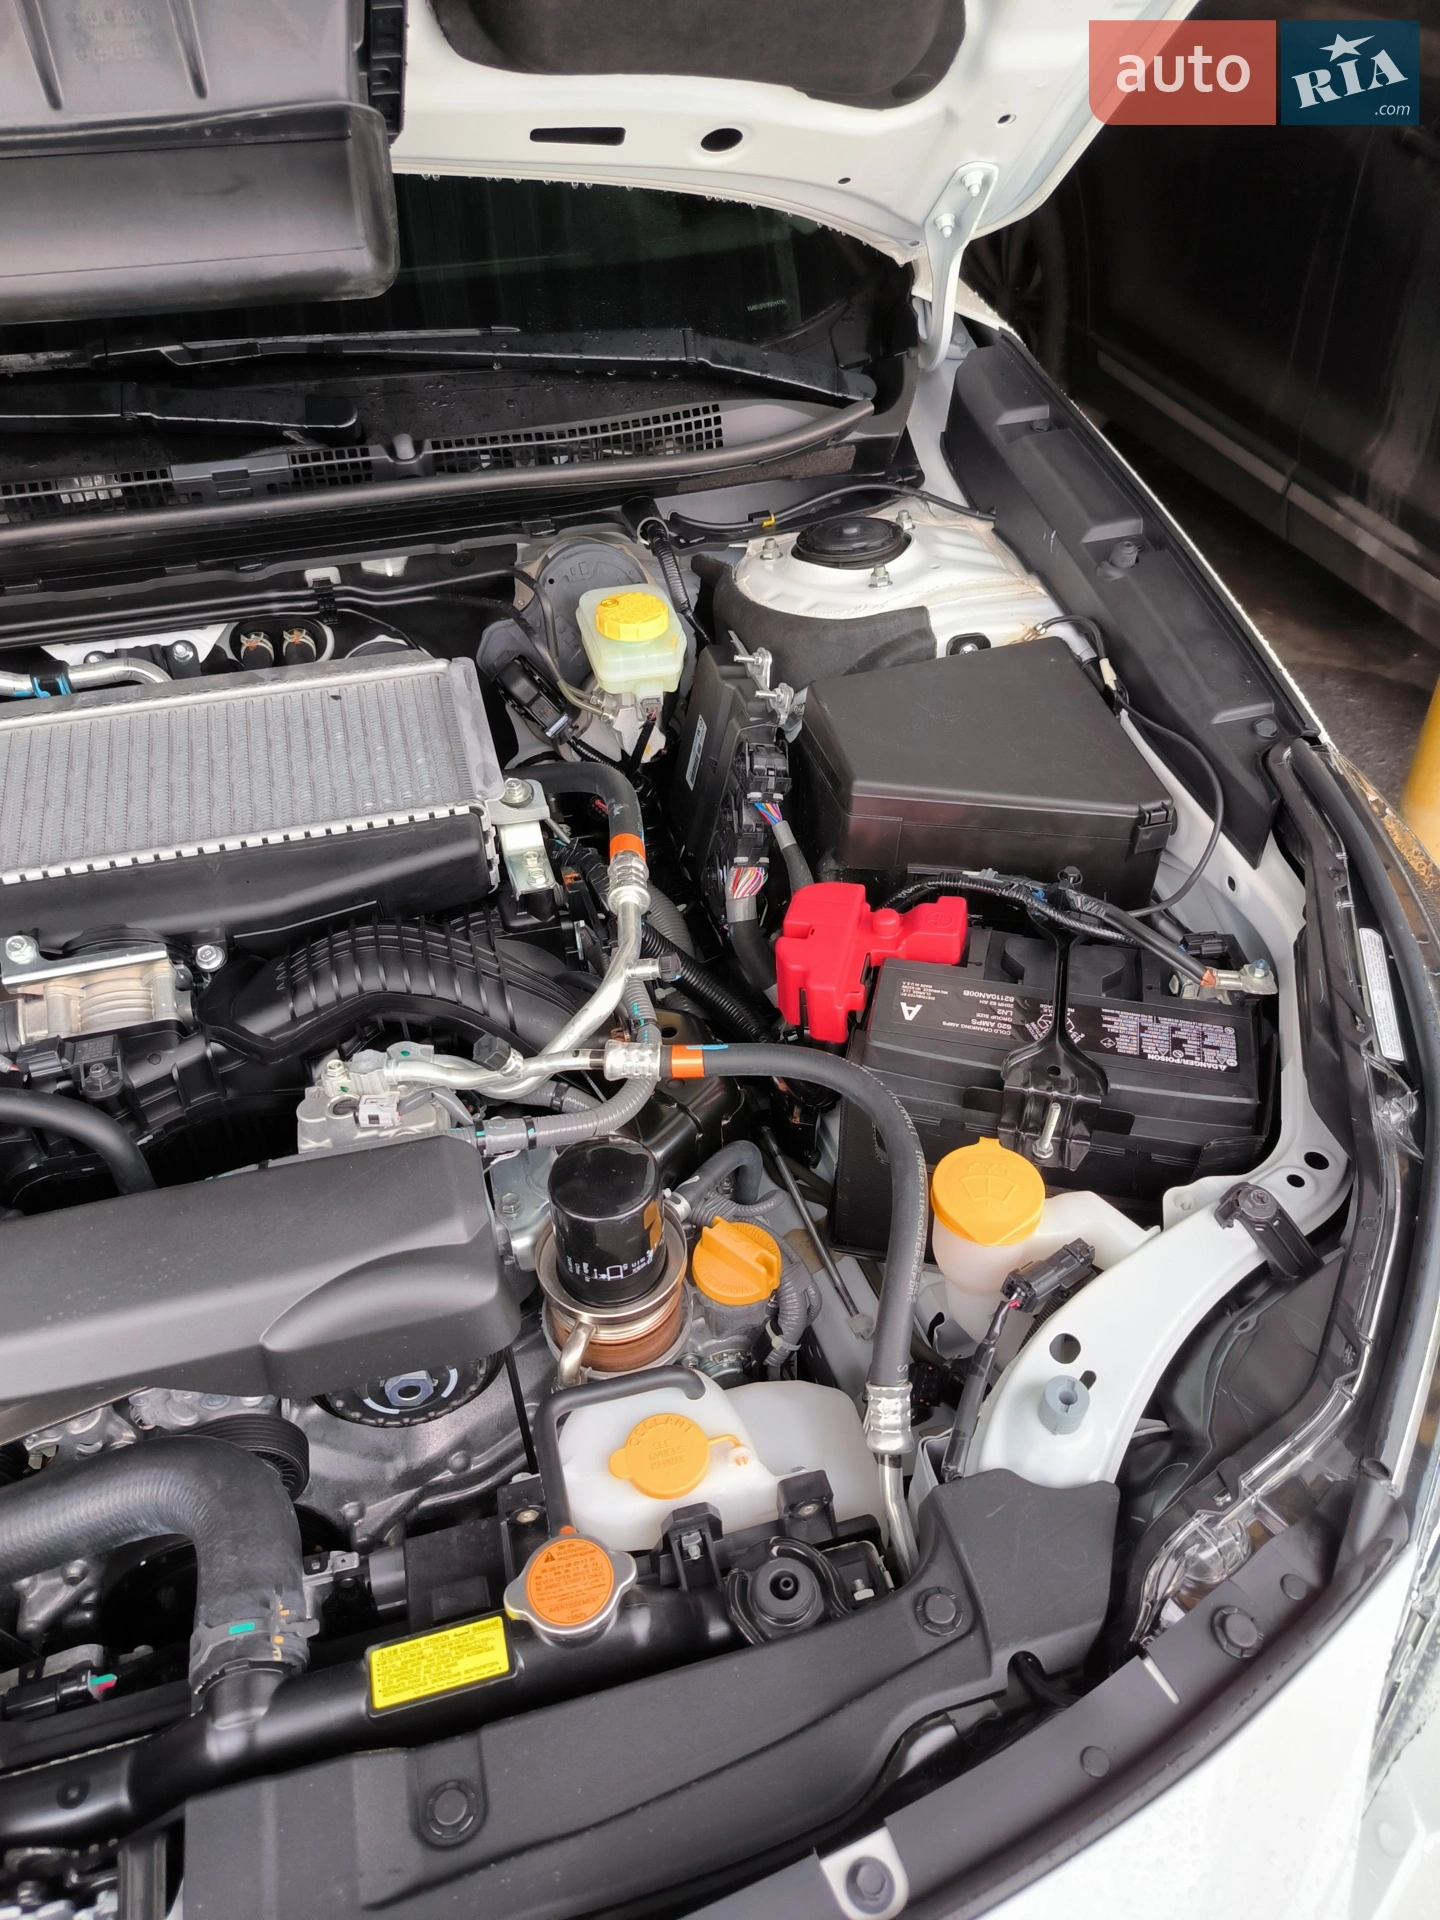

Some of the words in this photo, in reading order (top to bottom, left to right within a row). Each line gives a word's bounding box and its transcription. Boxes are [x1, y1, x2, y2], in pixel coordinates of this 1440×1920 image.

[963, 989, 1015, 1003] 82110AN00B
[900, 1001, 923, 1021] A
[996, 1008, 1013, 1016] LN2
[971, 1018, 996, 1028] AMPS
[990, 1014, 1013, 1023] GROUP
[960, 1023, 993, 1033] CRANKING
[997, 1022, 1012, 1030] 620
[994, 1028, 1011, 1036] COLD
[1147, 1053, 1219, 1070] DANGER/POISON
[400, 1643, 421, 1653] CAUTION
